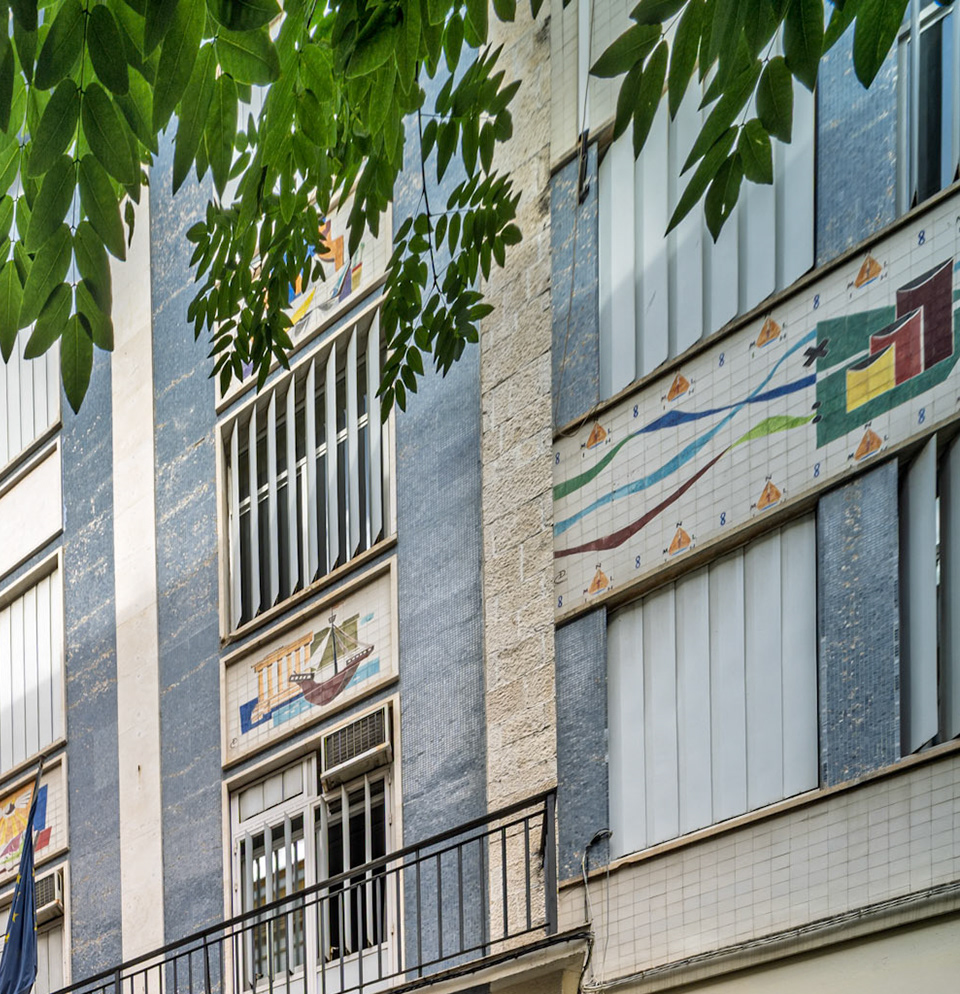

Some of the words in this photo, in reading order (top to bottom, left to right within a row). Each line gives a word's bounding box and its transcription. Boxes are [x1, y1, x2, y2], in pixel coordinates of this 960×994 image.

[918, 230, 926, 246] 8
[813, 294, 820, 310] 8
[719, 352, 725, 367] 8
[633, 404, 639, 418] 8
[918, 408, 926, 425] 8
[555, 452, 561, 465] 8
[813, 462, 821, 478] 8
[720, 511, 726, 526] 8
[635, 555, 641, 569] 8
[558, 595, 563, 608] 8
